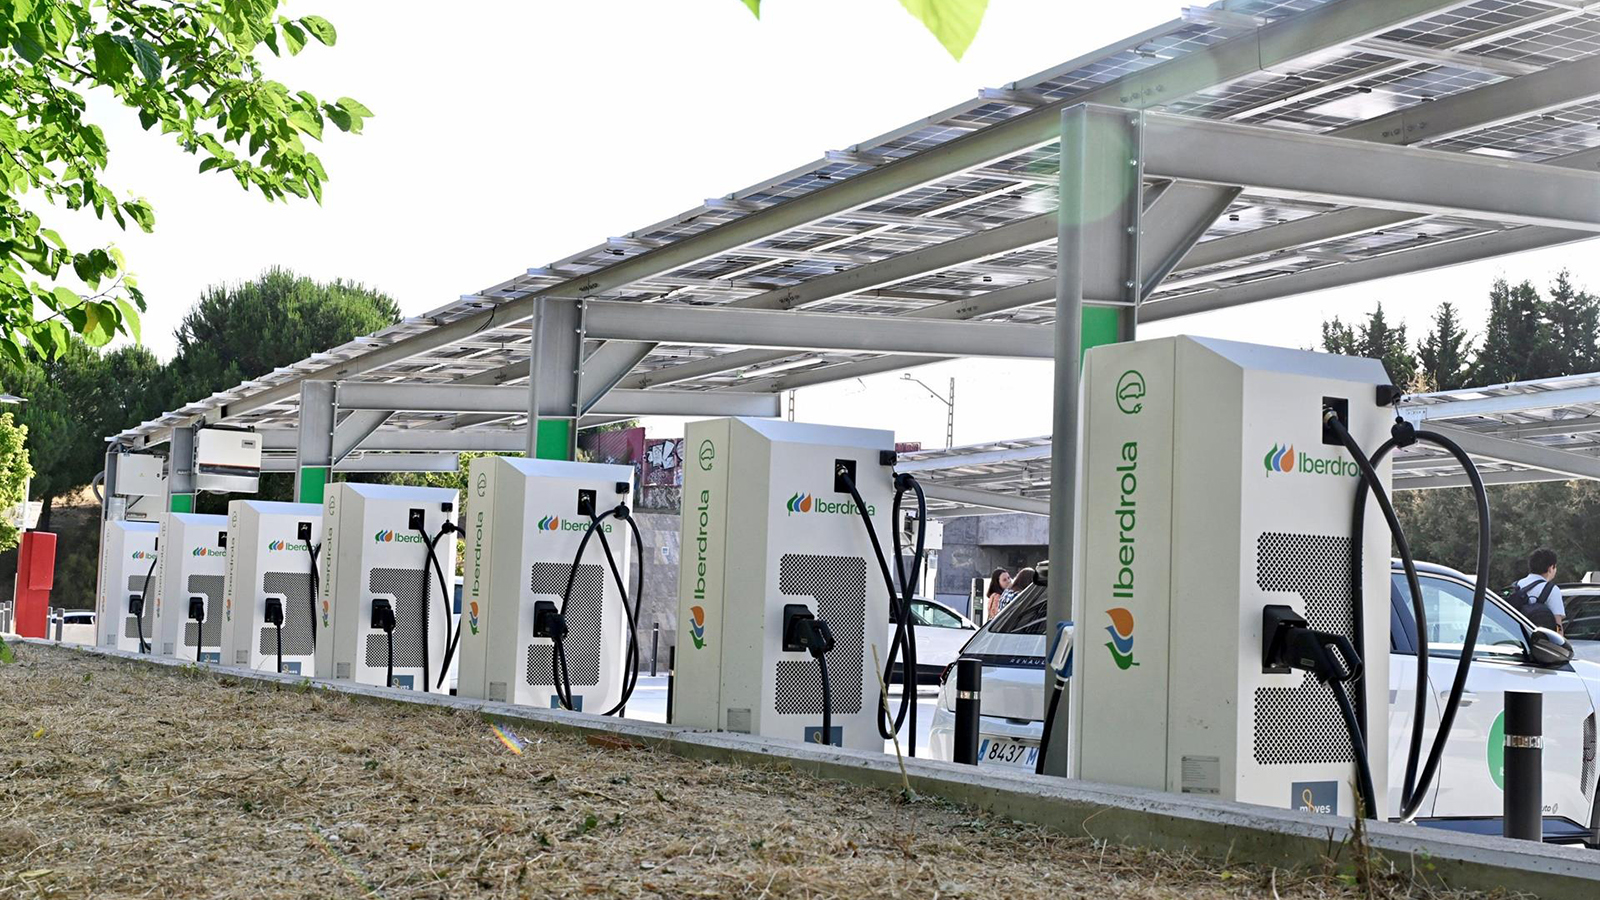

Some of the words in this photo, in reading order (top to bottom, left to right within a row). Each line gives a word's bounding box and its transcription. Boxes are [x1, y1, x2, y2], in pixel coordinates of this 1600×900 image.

[472, 511, 484, 596] Iberdrola
[561, 519, 612, 533] Iberdla
[694, 490, 709, 599] Iberdrola
[1113, 442, 1137, 598] Iberdrola
[324, 527, 333, 597] Iberdrola
[989, 743, 1026, 763] 8437
